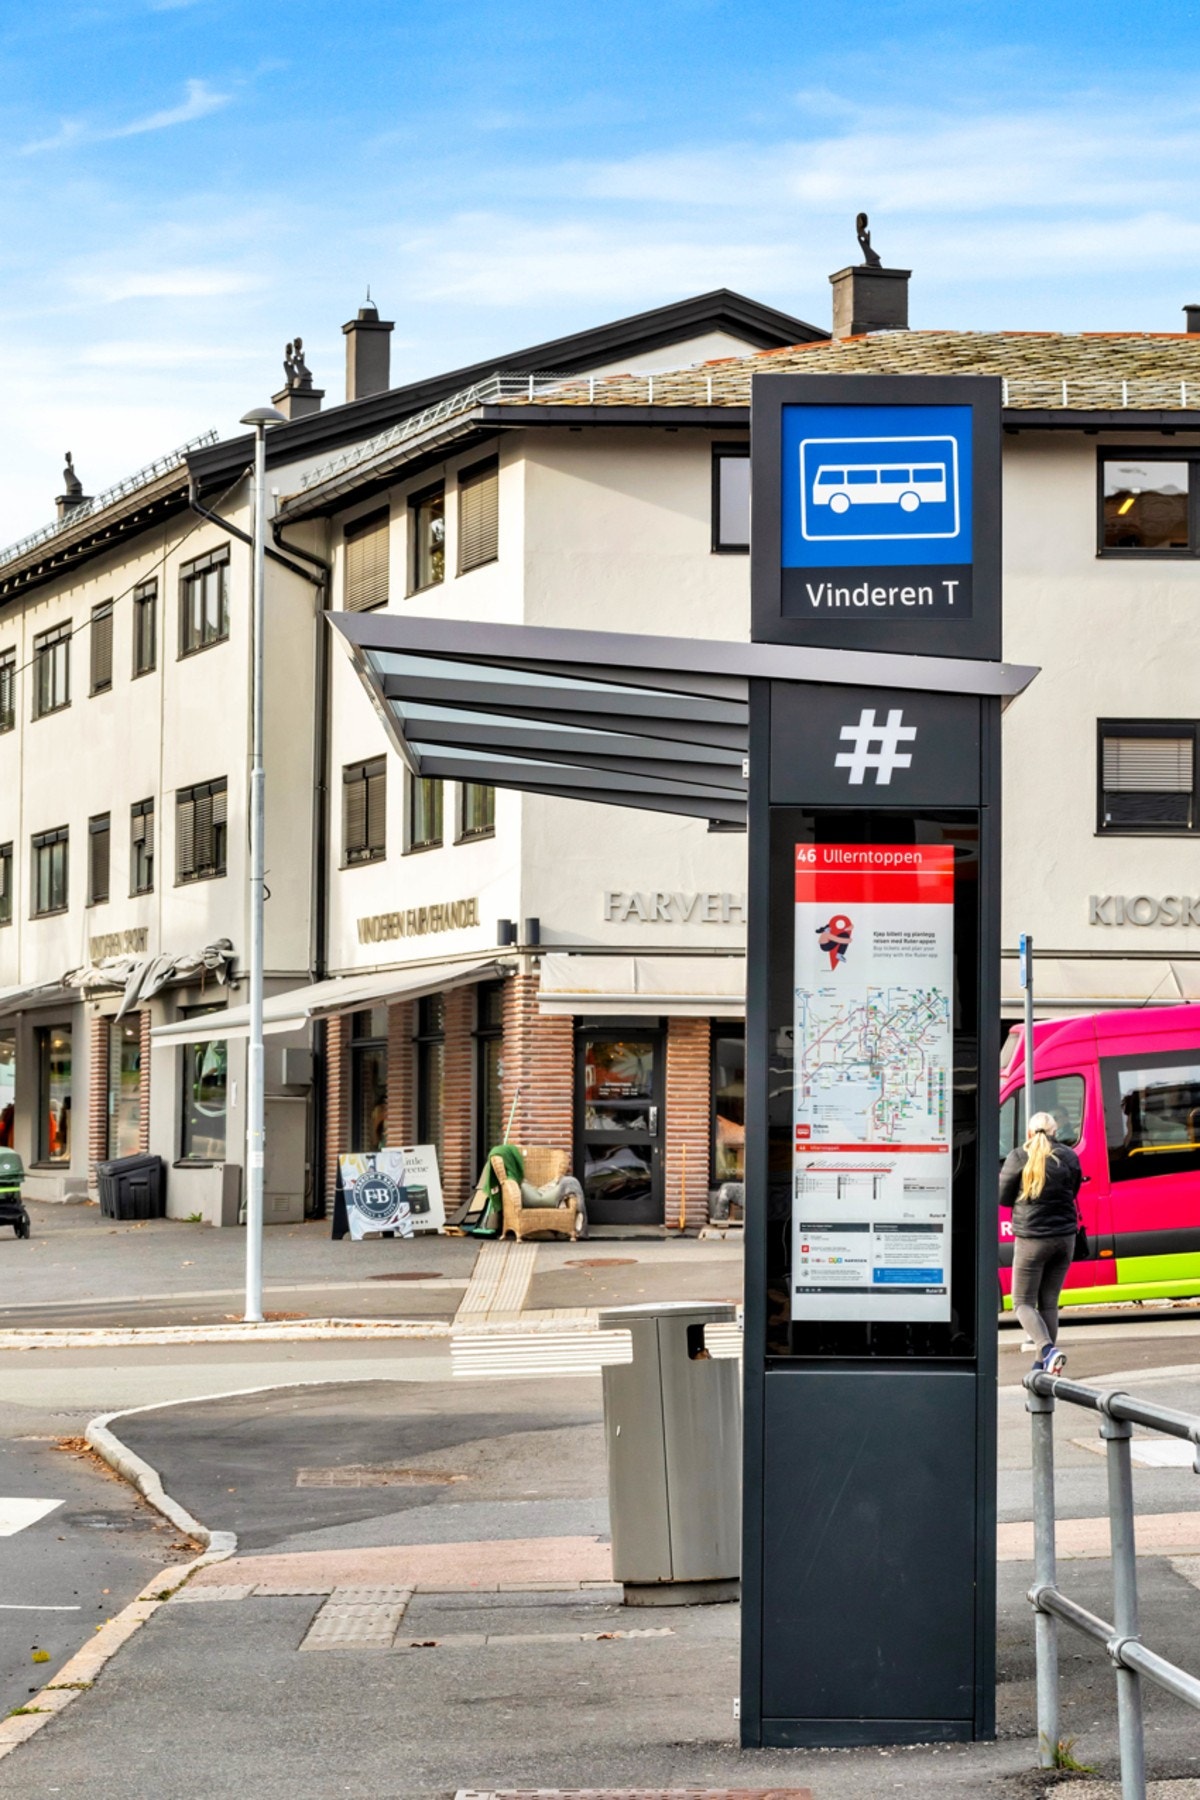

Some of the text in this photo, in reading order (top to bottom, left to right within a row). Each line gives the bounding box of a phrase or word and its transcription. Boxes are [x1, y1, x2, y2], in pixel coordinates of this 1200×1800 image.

[806, 580, 960, 607] Vinderen T
[797, 849, 923, 867] 46 Ullerntoppen
[1089, 895, 1200, 927] KIOSK
